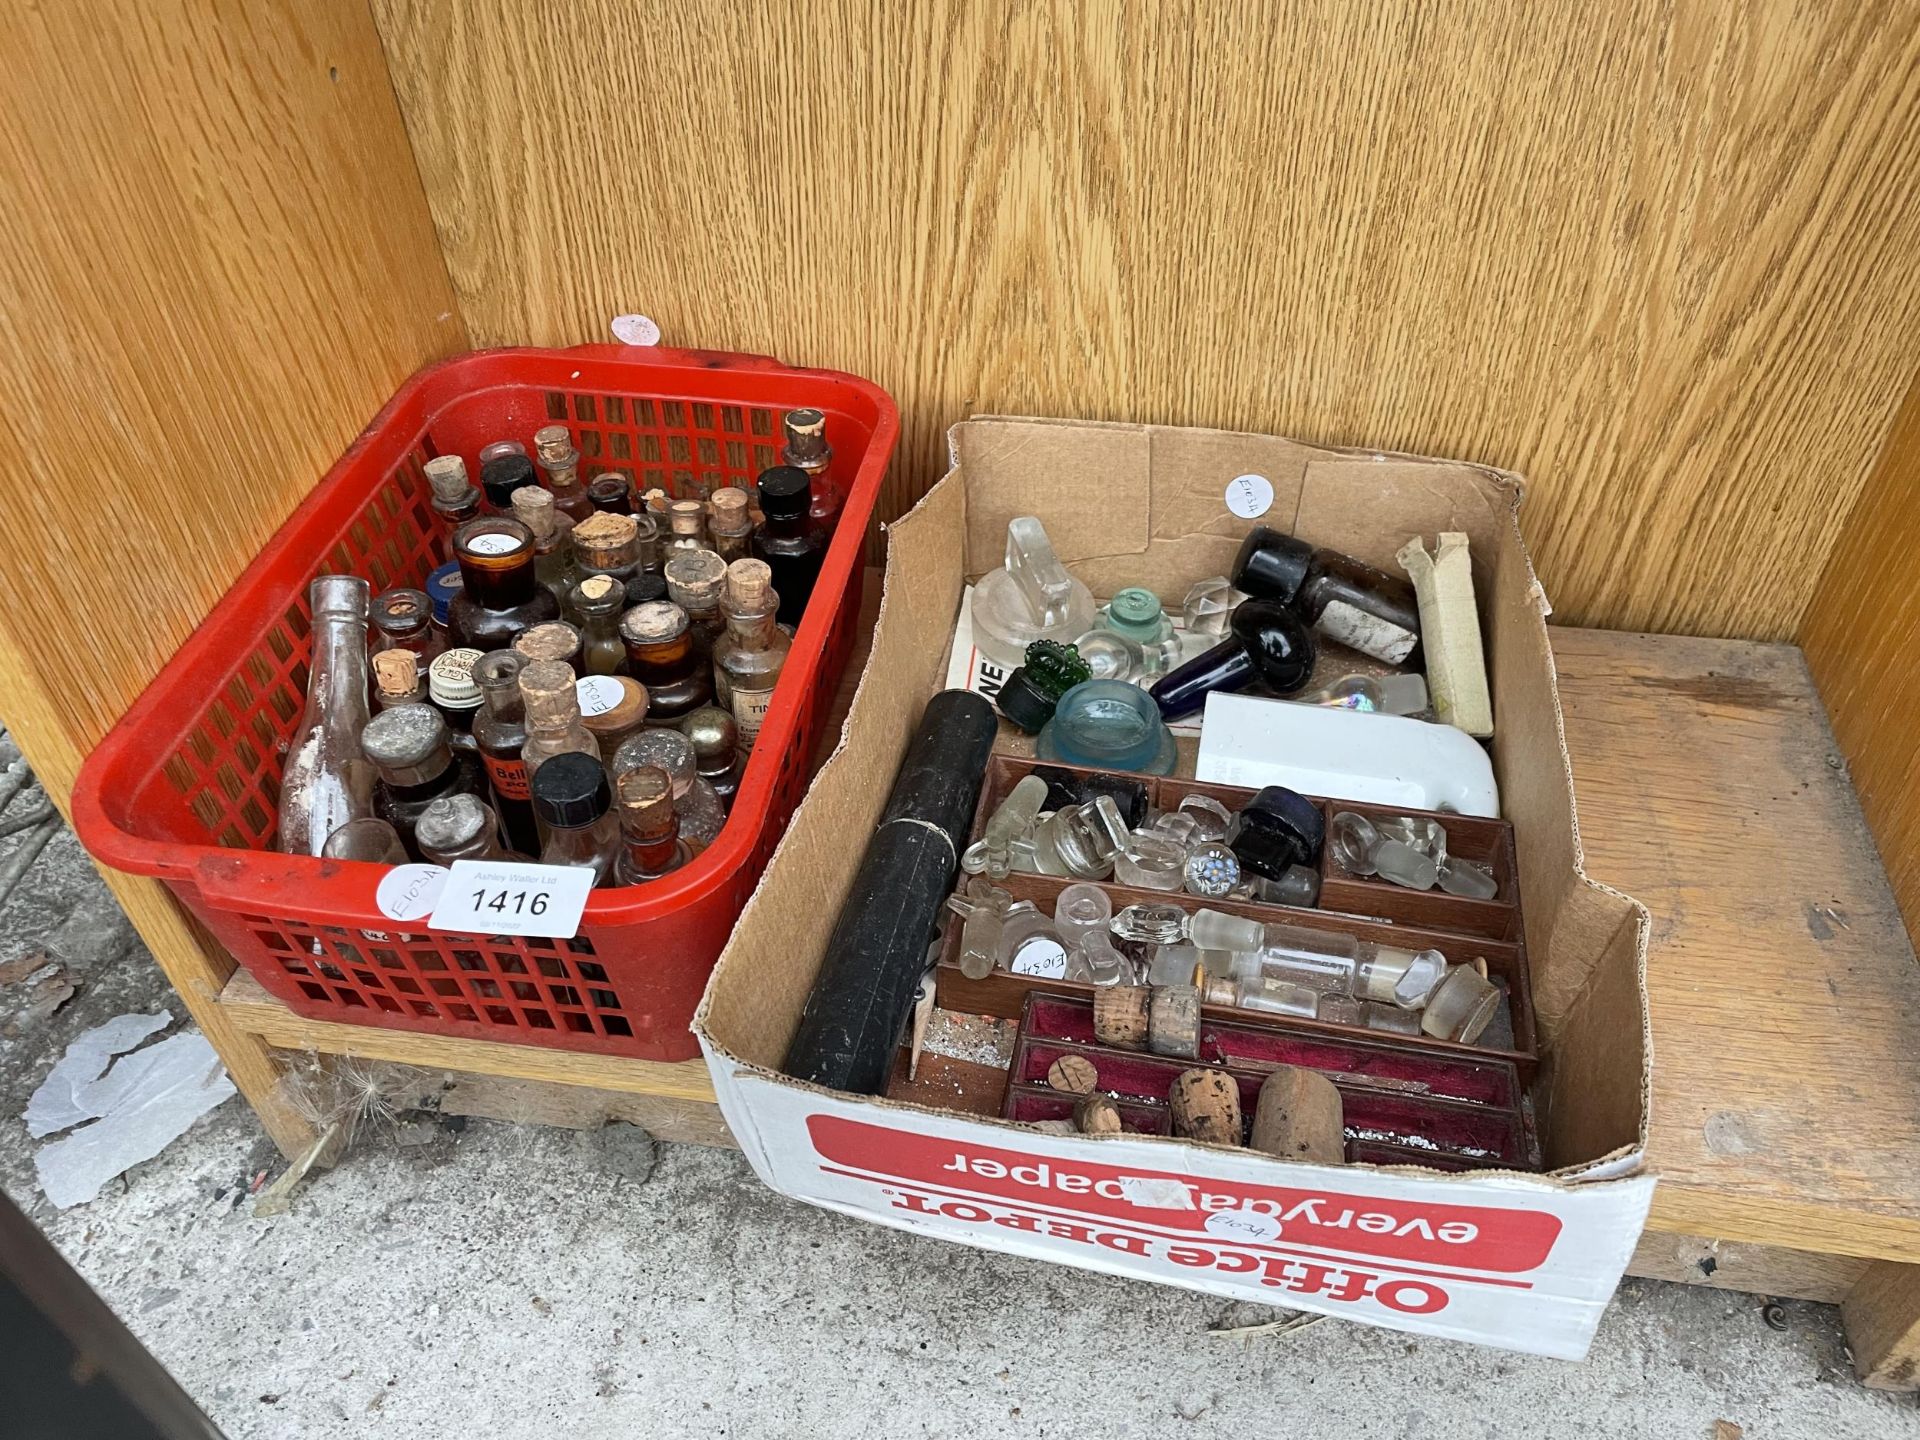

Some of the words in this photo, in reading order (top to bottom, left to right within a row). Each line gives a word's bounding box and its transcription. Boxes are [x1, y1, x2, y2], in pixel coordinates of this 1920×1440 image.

[979, 656, 1004, 698] NE
[474, 871, 506, 883] Ashley
[541, 875, 558, 885] Ltd
[472, 888, 550, 916] 1416
[943, 1153, 1125, 1201] paper
[1167, 1245, 1450, 1314] Office
